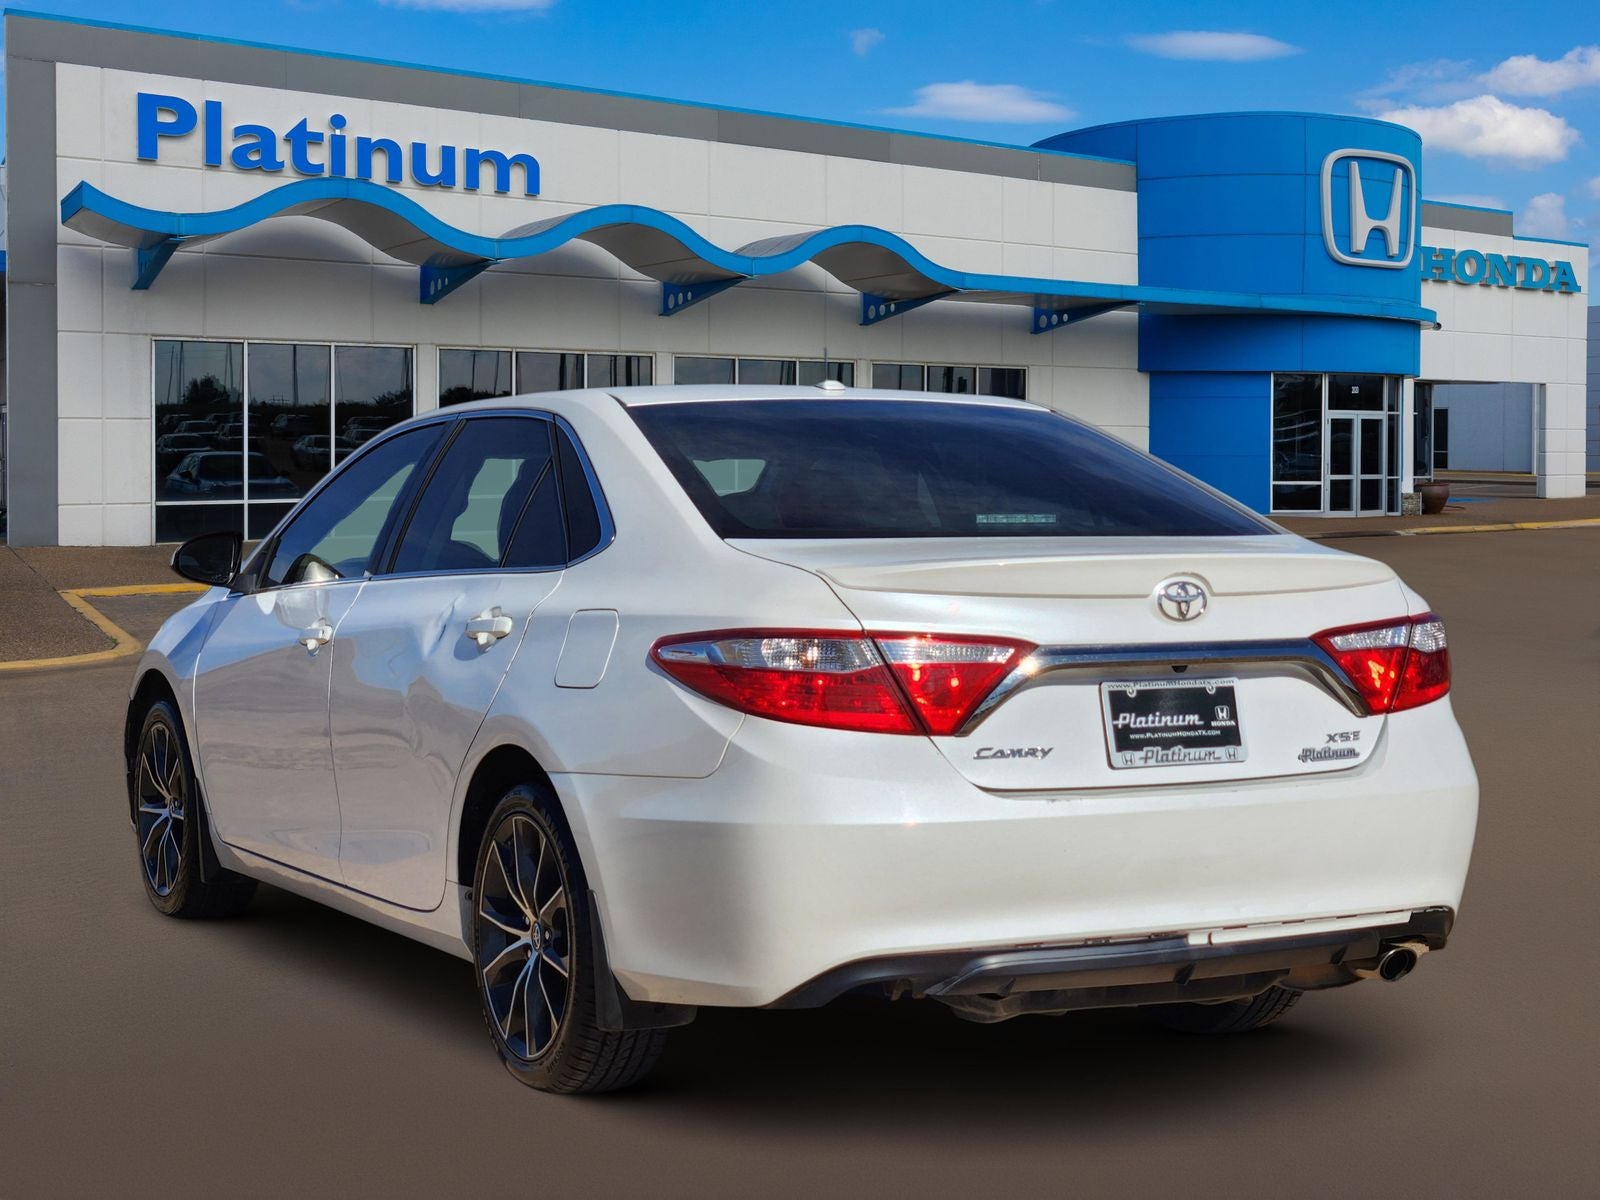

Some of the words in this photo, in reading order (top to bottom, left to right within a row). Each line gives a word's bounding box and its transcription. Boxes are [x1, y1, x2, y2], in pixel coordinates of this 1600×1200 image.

[137, 92, 541, 196] Platinum
[1421, 246, 1581, 293] HONDA
[1113, 711, 1204, 728] Platinum
[1325, 731, 1360, 744] XSE
[973, 747, 1054, 760] CAMRY
[1138, 745, 1222, 764] Platinum
[1298, 746, 1360, 763] Platinum
